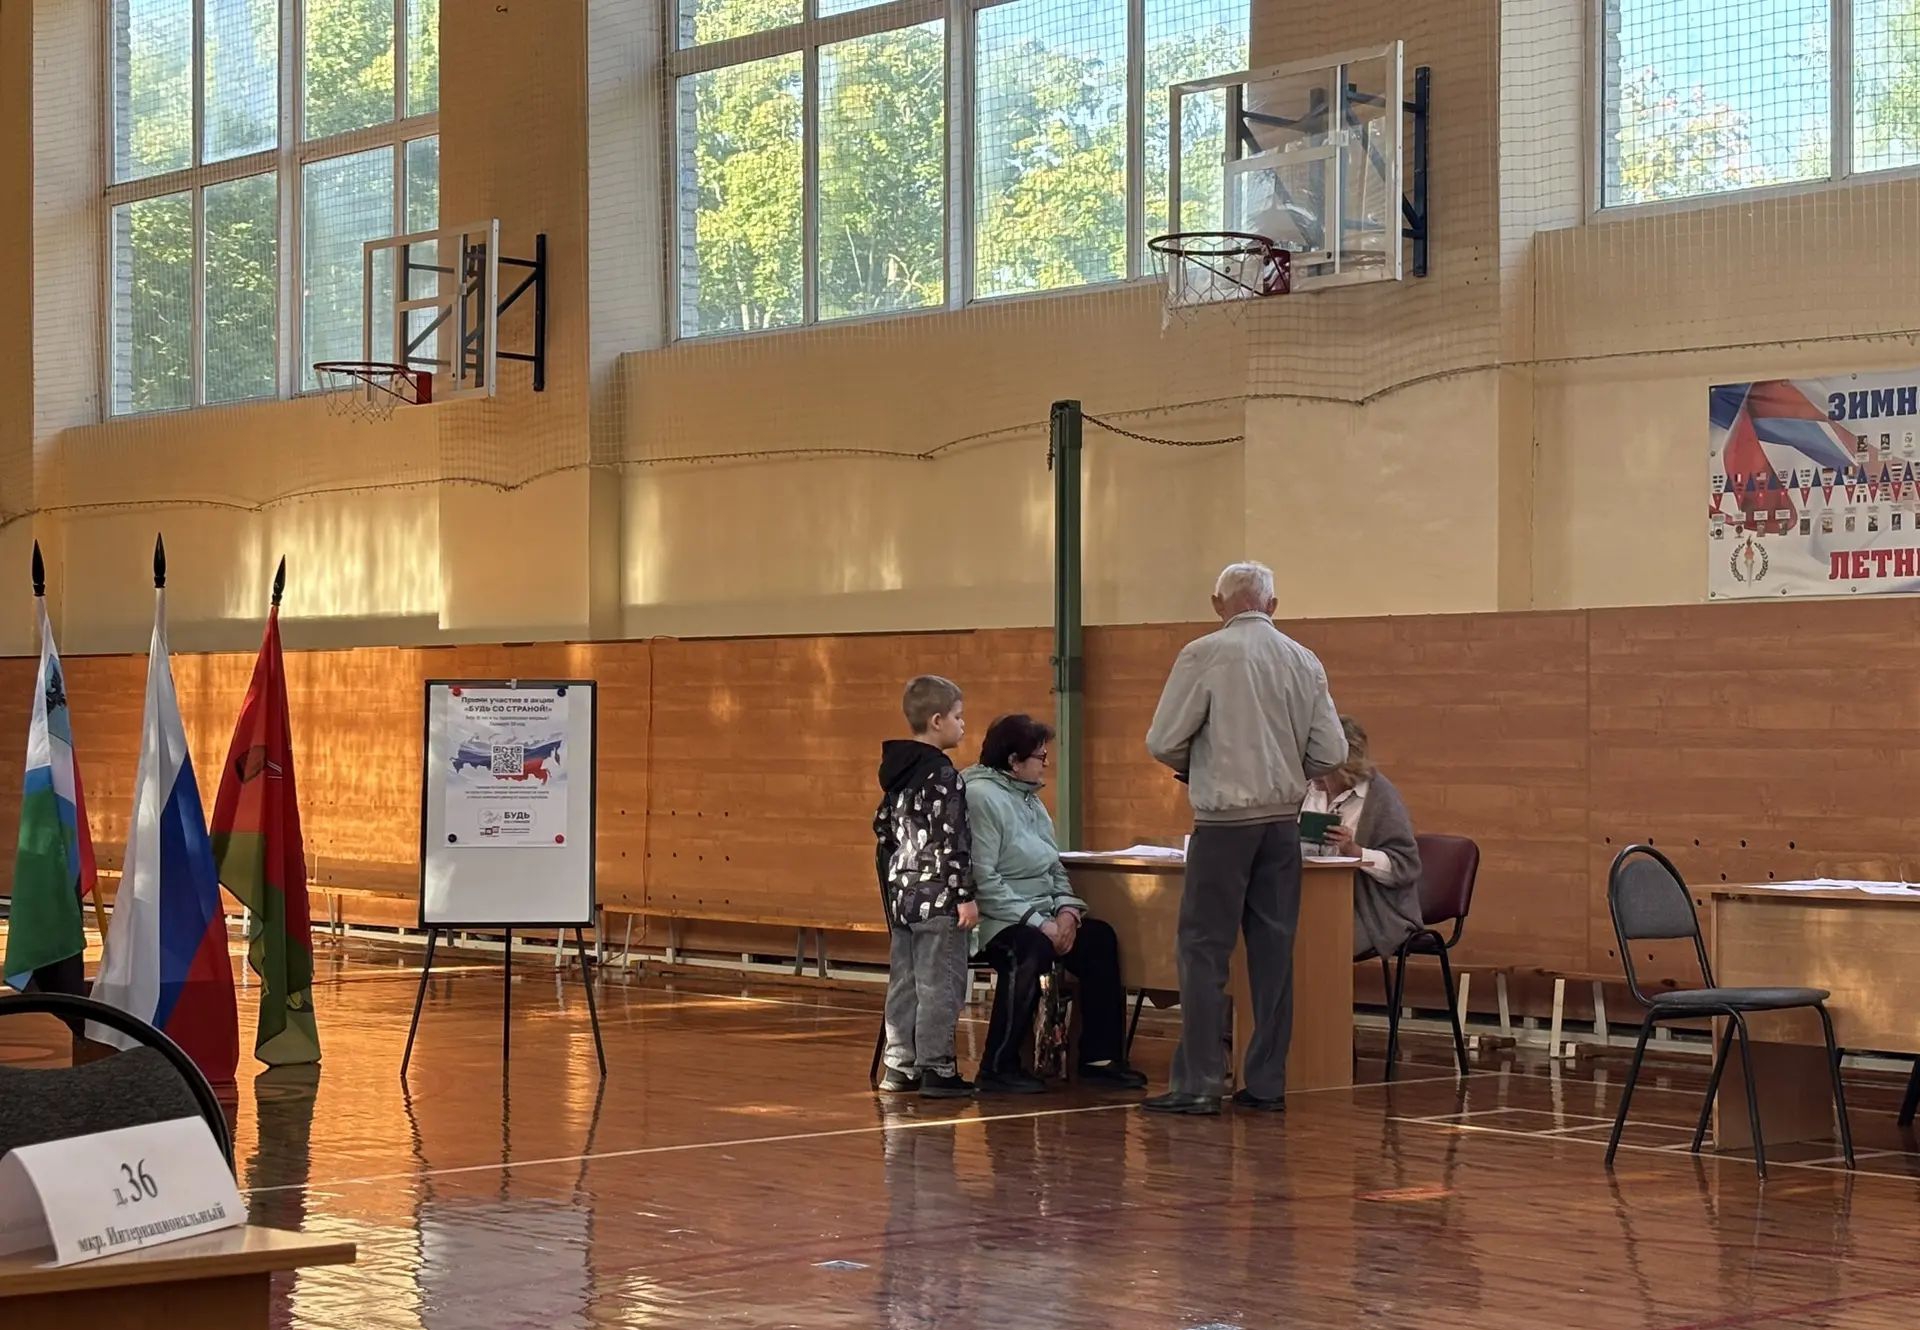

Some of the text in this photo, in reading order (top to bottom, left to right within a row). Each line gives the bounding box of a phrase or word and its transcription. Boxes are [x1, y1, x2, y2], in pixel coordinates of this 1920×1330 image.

[1828, 386, 1920, 421] ЗИМН
[1829, 547, 1920, 580] ЛЕТН
[504, 811, 530, 819] БУДЬ
[77, 1202, 226, 1254] мкр. Интернациональный
